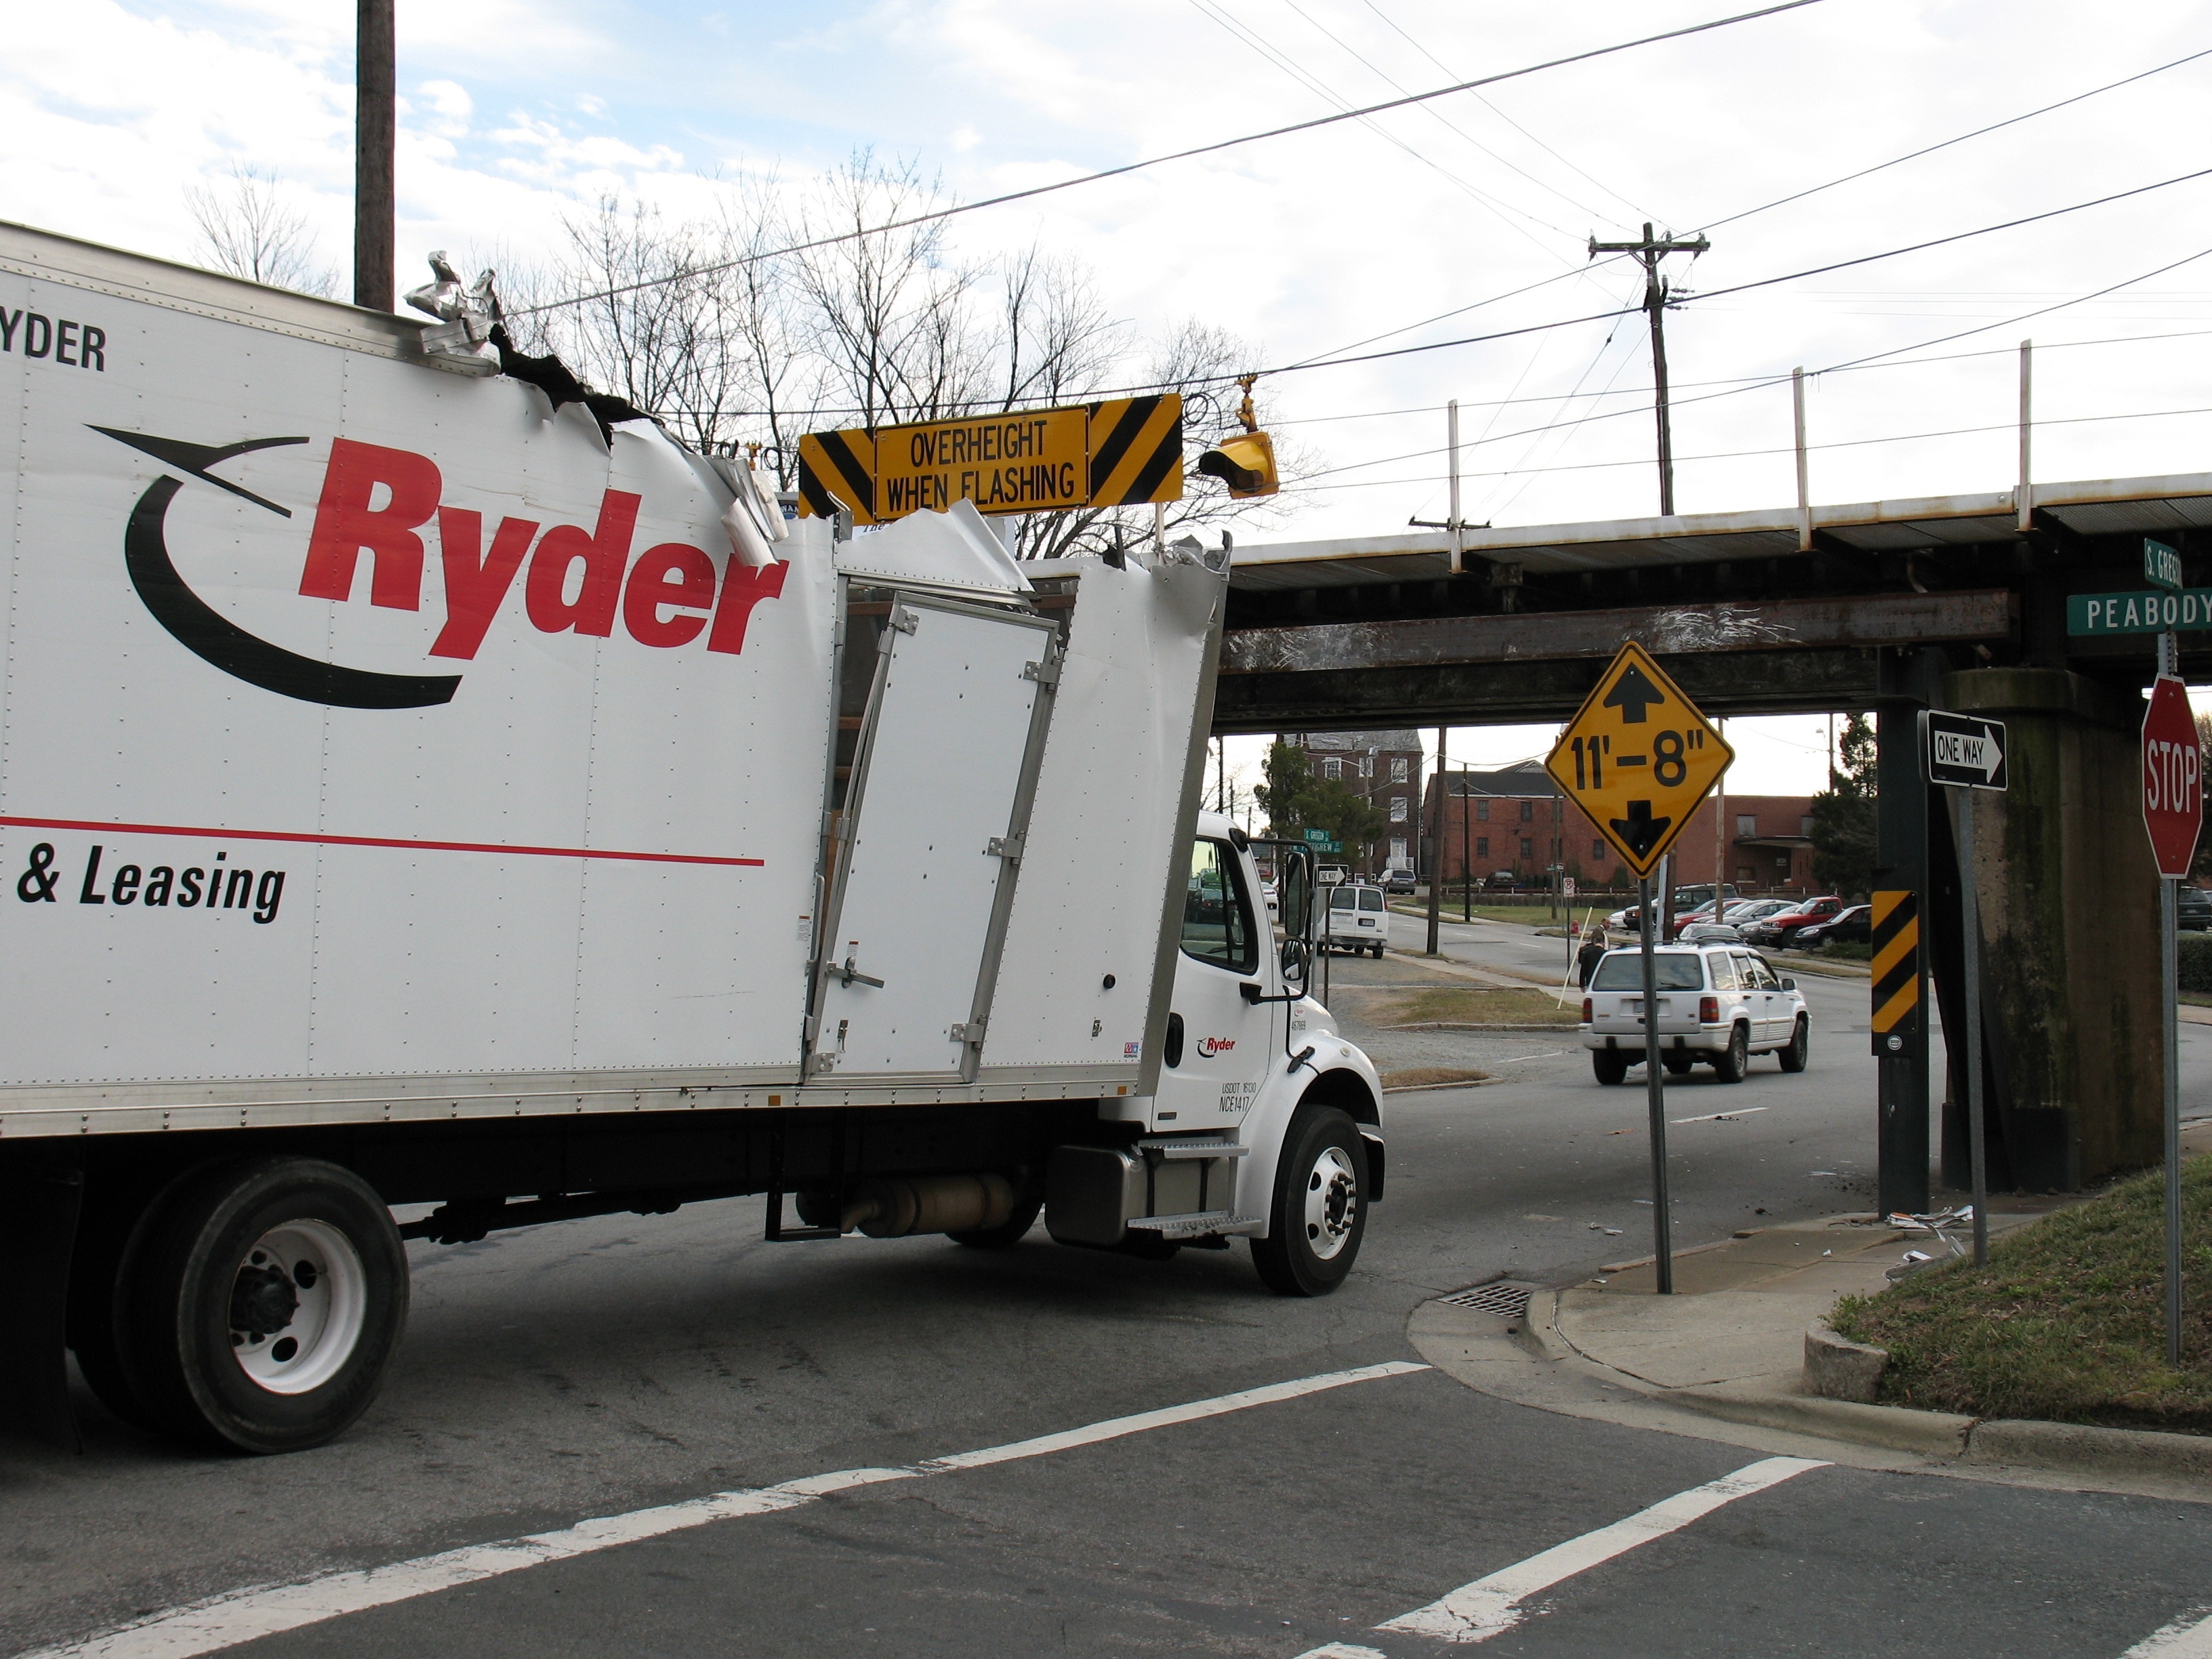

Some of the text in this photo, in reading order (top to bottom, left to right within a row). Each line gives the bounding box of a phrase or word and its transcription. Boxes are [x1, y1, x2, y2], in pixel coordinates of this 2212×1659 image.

[911, 420, 1047, 468] OVERHEIGHT
[887, 462, 1074, 512] WHEN FLASHING
[299, 437, 789, 660] Ryder
[2147, 546, 2154, 576] S.
[2087, 594, 2212, 629] PEABODY
[1938, 735, 1984, 765] ONE WAY
[2147, 739, 2198, 813] STOP
[17, 842, 286, 924] & Leasing
[1207, 1038, 1235, 1053] Ryder
[1219, 1097, 1250, 1111] NCE1417
[1223, 1083, 1240, 1093] USDOT
